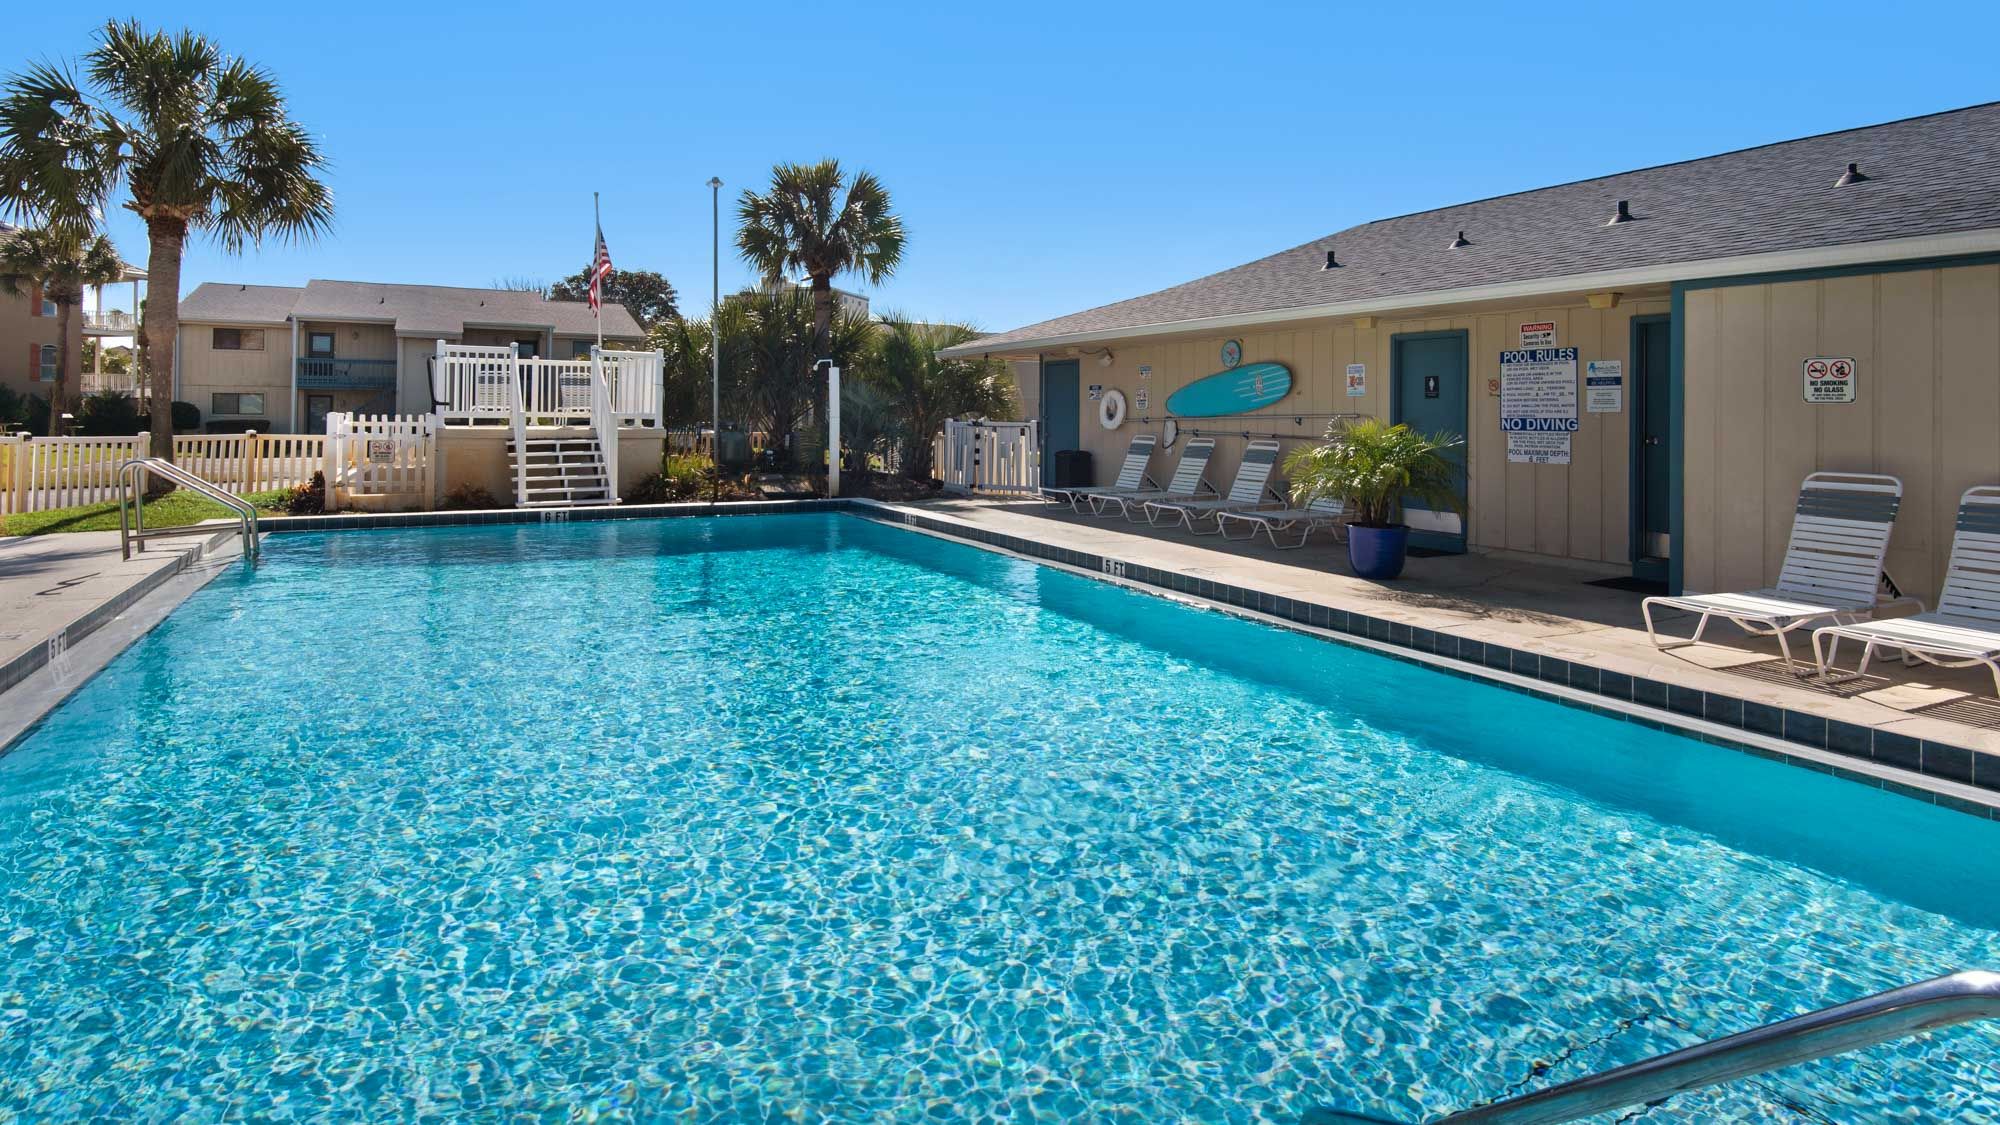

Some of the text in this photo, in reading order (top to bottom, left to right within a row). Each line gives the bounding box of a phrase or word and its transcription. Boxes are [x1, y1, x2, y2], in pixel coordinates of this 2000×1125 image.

[1504, 348, 1574, 363] POOL RULES
[1502, 418, 1578, 430] NO DIVING
[545, 512, 567, 521] 6 FT
[1106, 559, 1124, 577] 5 FT
